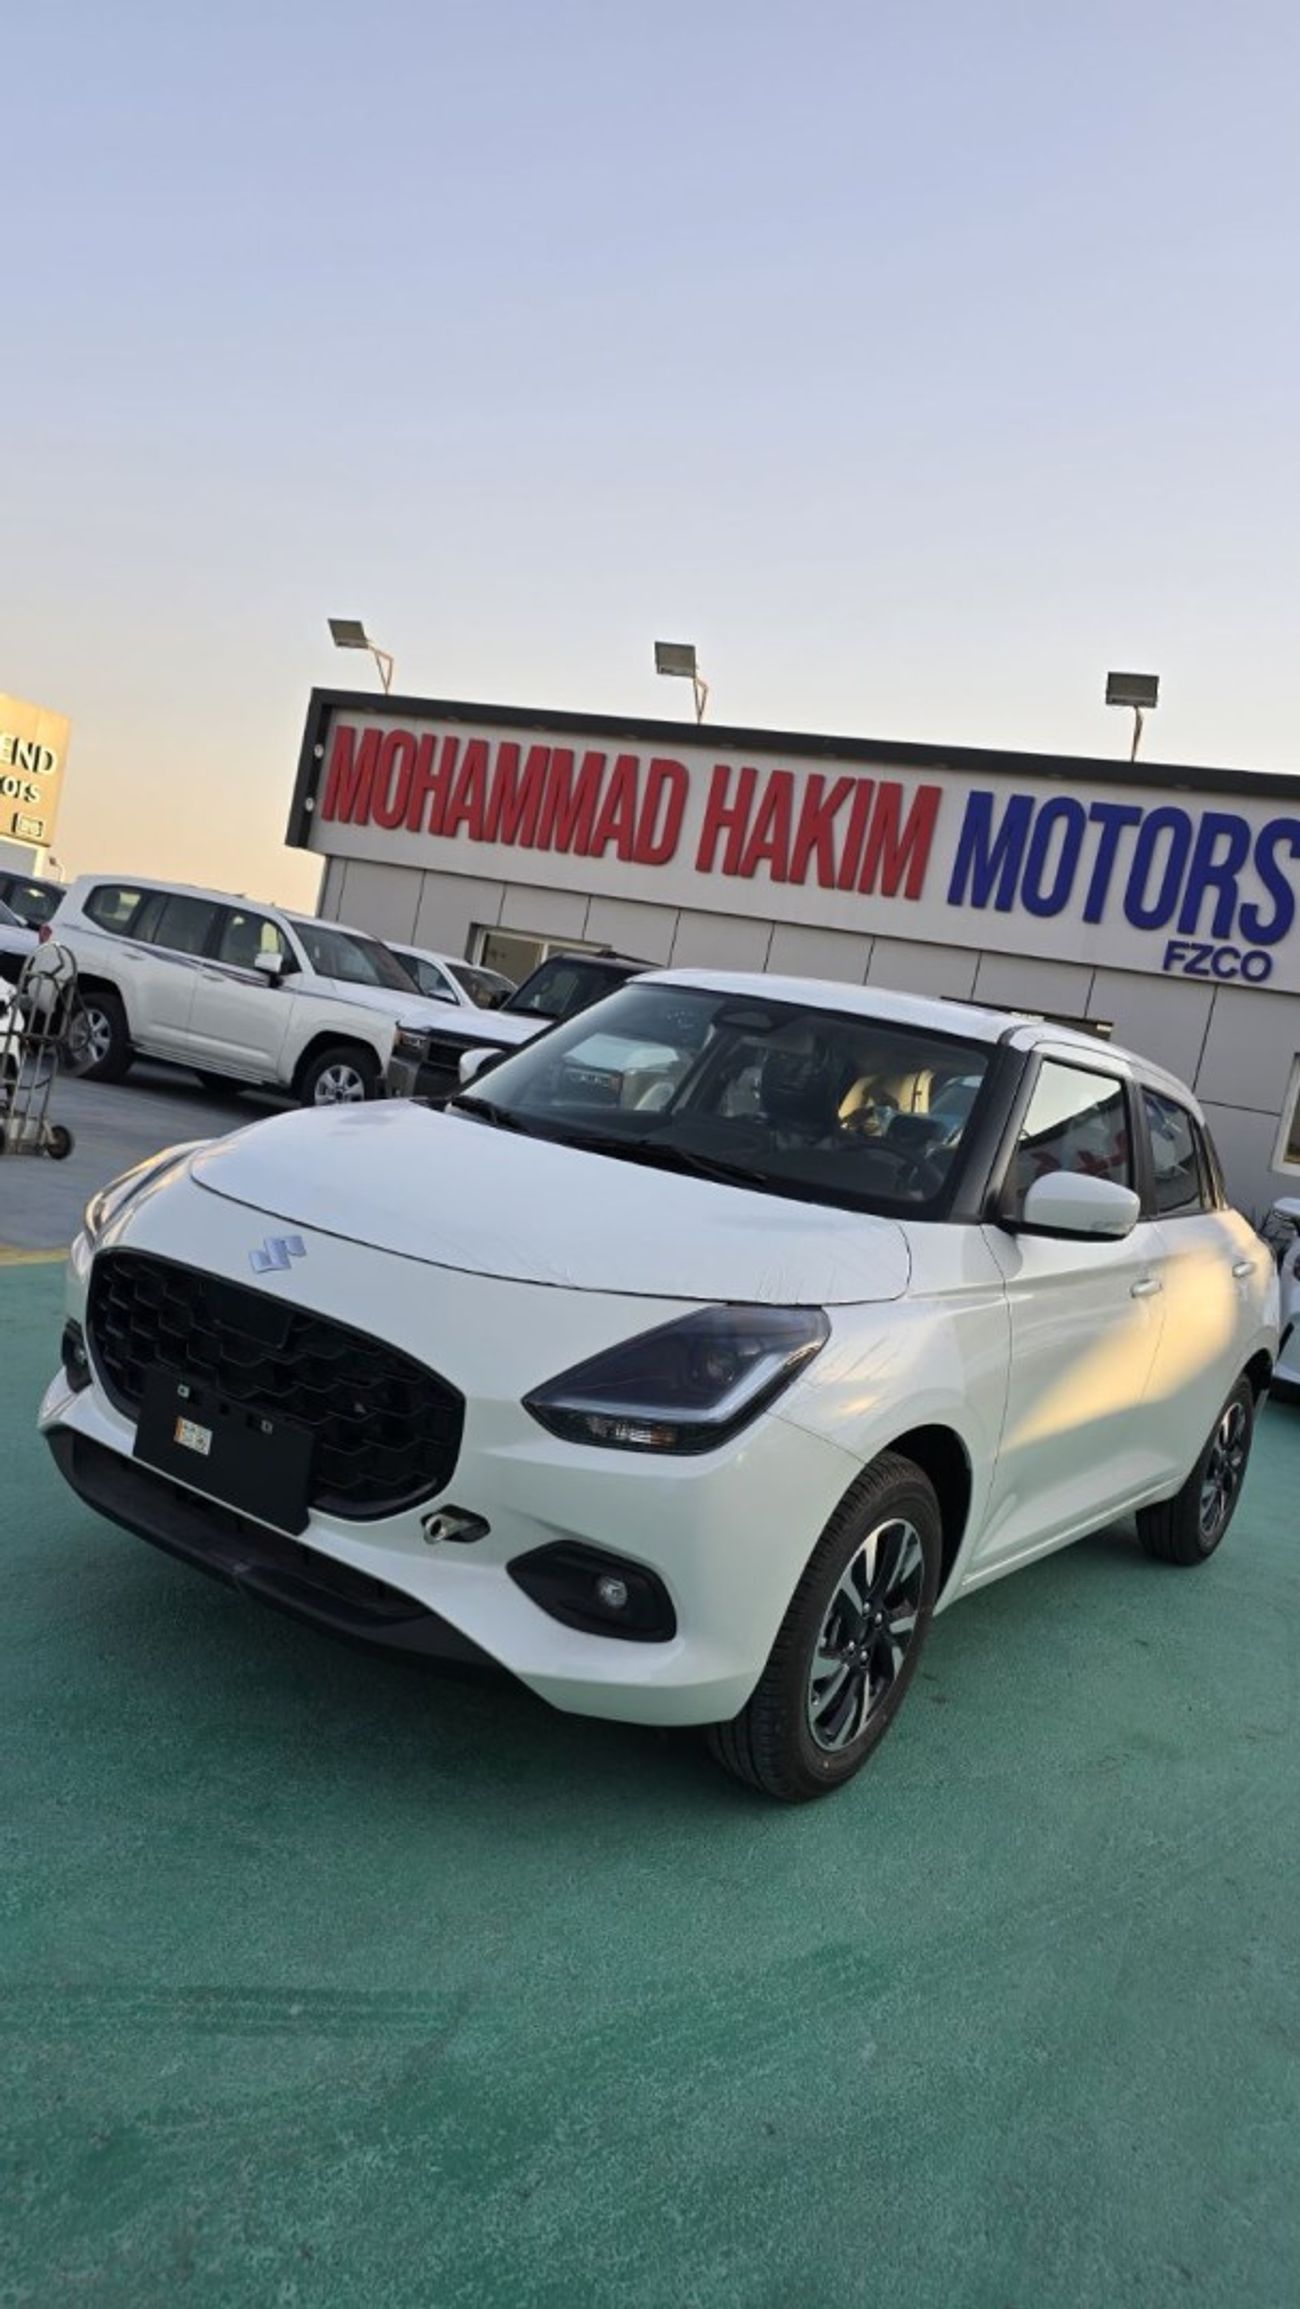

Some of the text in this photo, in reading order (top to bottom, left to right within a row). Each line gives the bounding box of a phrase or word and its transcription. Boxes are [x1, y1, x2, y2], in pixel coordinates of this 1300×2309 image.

[321, 725, 1300, 946] MOHAMMAD HAKIM MOTORS
[1162, 940, 1274, 982] FZCO
